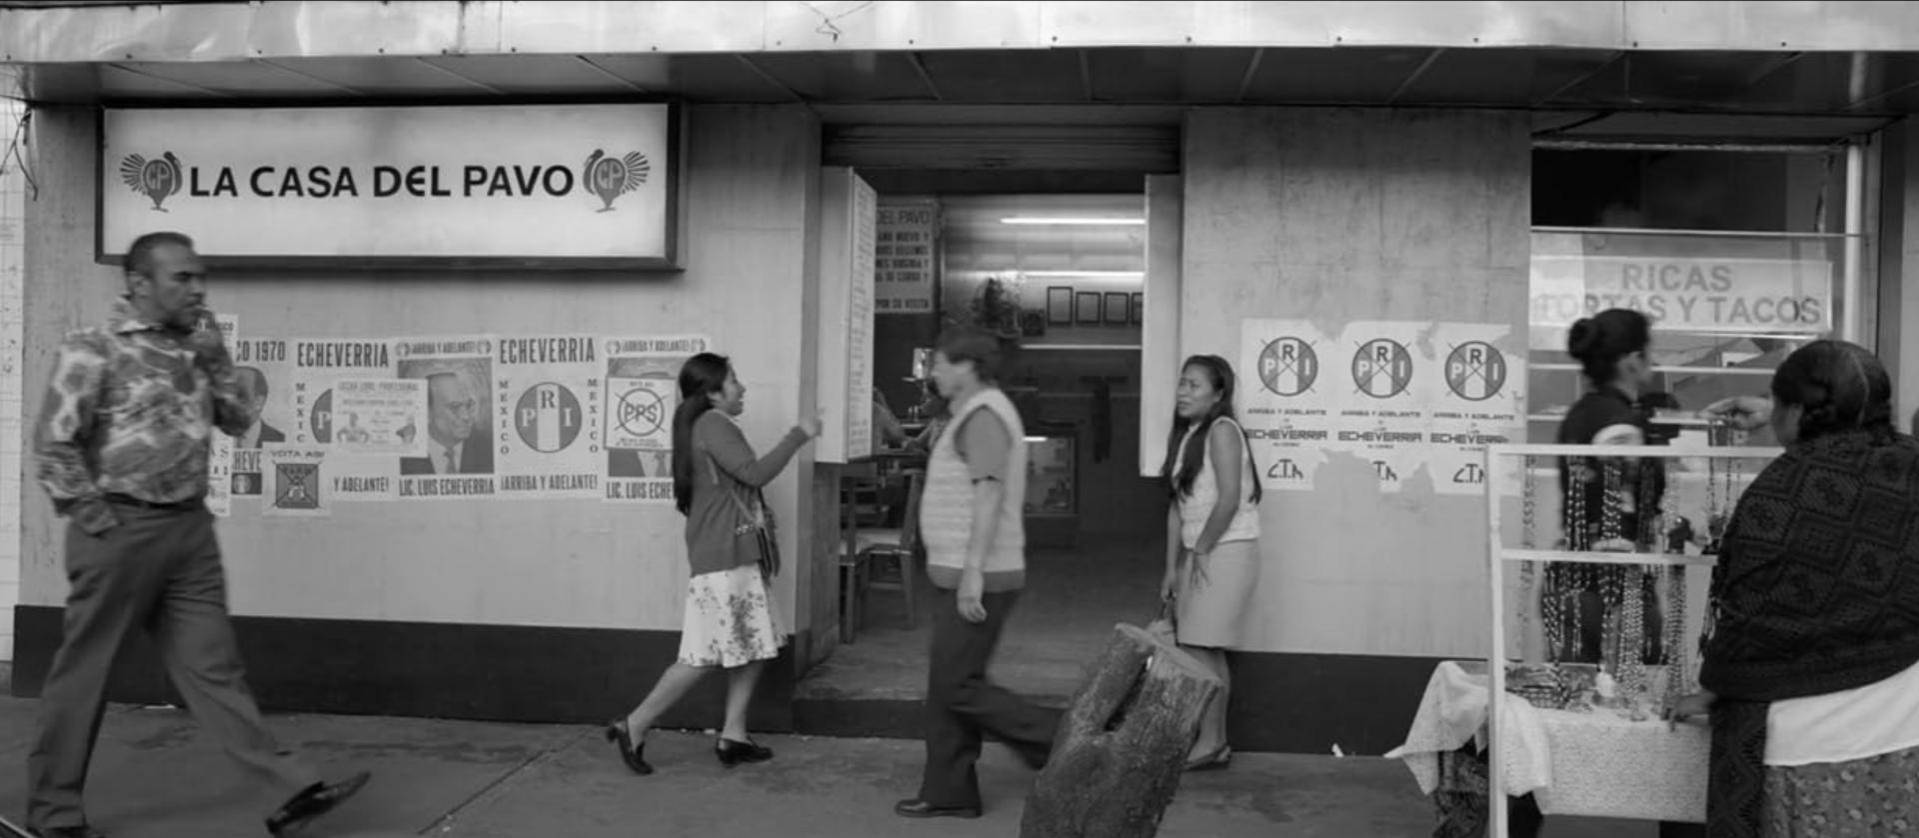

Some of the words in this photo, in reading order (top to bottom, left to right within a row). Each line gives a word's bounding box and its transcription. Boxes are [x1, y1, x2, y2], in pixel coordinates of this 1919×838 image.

[190, 168, 239, 197] LA
[249, 167, 359, 197] CASA
[373, 166, 451, 197] DEL
[463, 165, 575, 197] PAVO
[1621, 264, 1733, 292] RICAS
[1676, 297, 1698, 322] Y
[1706, 296, 1822, 325] TACOS
[255, 341, 286, 362] 1970
[297, 342, 389, 368] ECHEVERRIA
[499, 338, 596, 364] ECHEVERRIA
[1264, 343, 1311, 376] PRI
[1358, 345, 1405, 378] PRI
[1451, 348, 1499, 381] PRI
[498, 380, 509, 455] MEXICO
[521, 389, 573, 428] PRI
[587, 378, 599, 453] MEXICO
[1284, 408, 1327, 416] ADELANTE
[1471, 413, 1515, 421] ADELANTE
[1244, 429, 1328, 440] ECHEVERRIA
[1337, 431, 1422, 442] ECHEVERRIA
[333, 478, 340, 492] Y
[341, 476, 389, 492] ADELANTE!
[399, 478, 417, 496] LIC.
[418, 478, 438, 496] LUIS
[439, 477, 495, 496] ECHEVERRIA
[540, 475, 547, 490] Y
[548, 474, 598, 490] ADELANTE!
[606, 481, 624, 498] LIC.
[626, 481, 647, 498] LUIS
